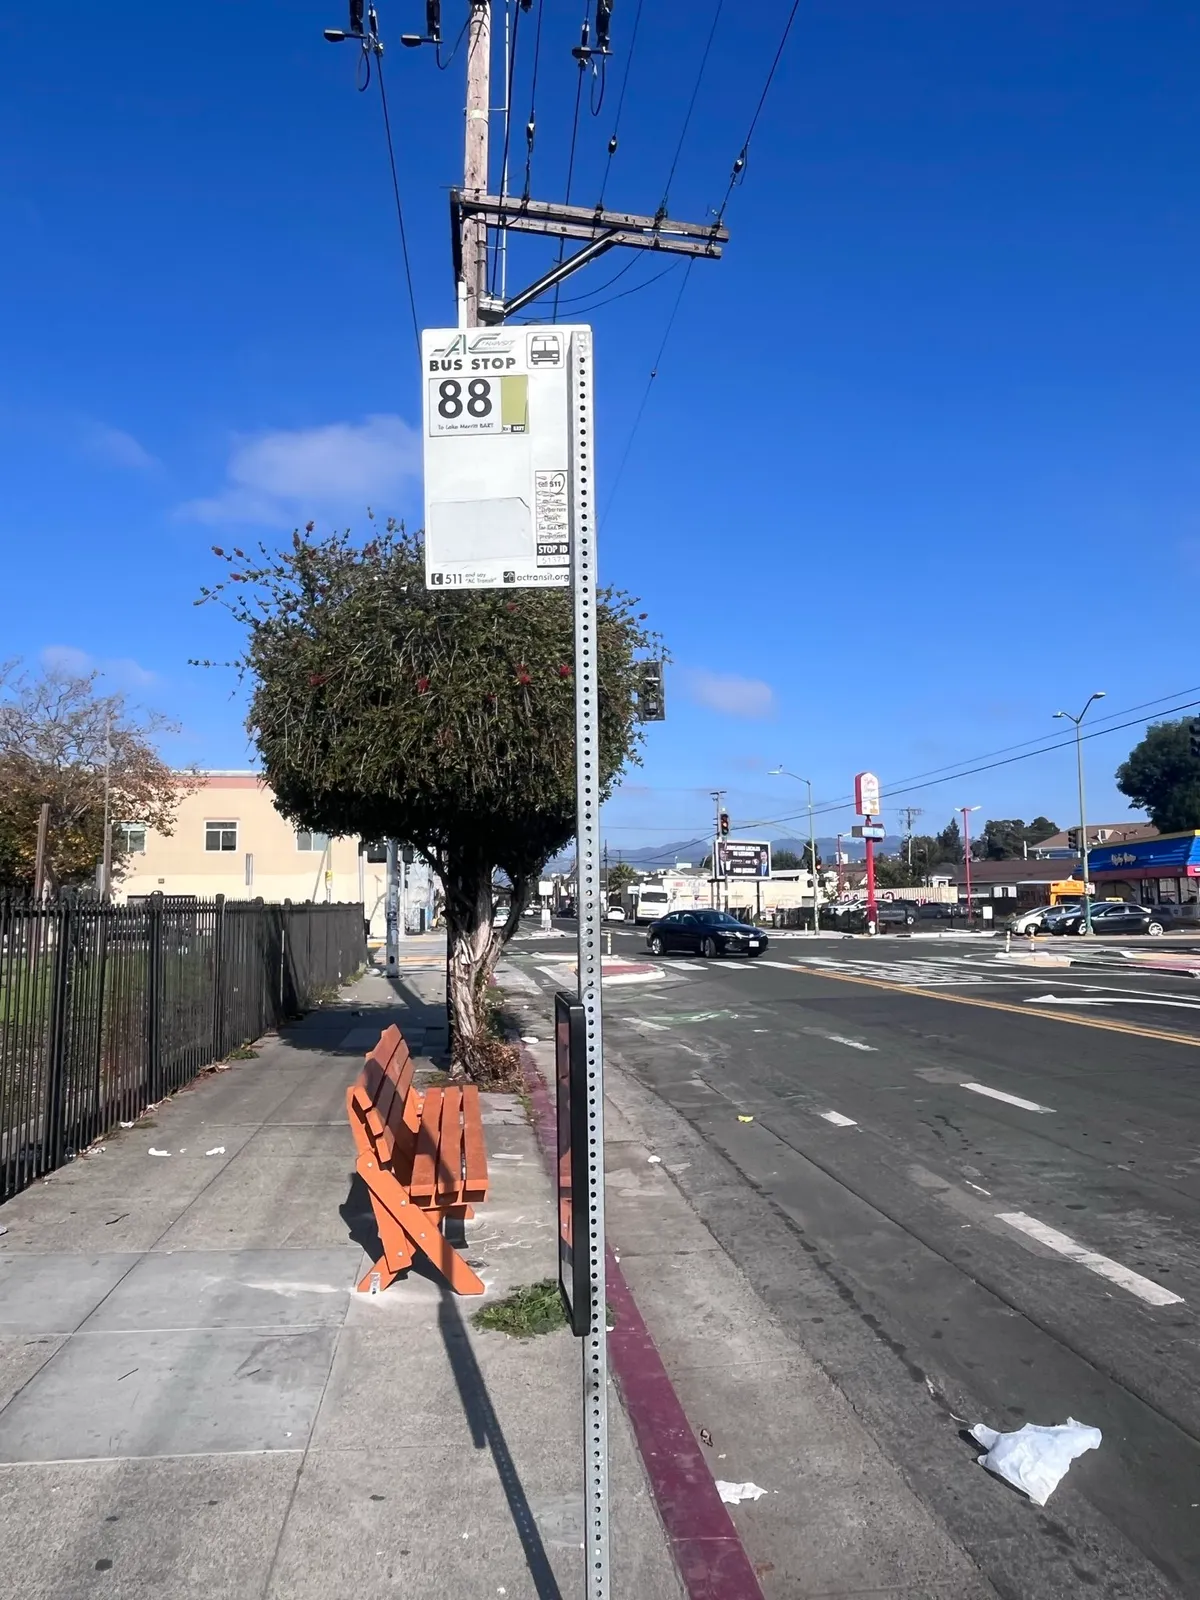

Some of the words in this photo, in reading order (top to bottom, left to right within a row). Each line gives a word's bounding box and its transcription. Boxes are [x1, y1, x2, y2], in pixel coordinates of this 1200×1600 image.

[429, 359, 463, 372] BUS
[471, 357, 516, 371] STOP
[438, 378, 492, 419] 88
[538, 544, 558, 554] STOP
[559, 544, 568, 554] ID
[445, 573, 463, 585] 511
